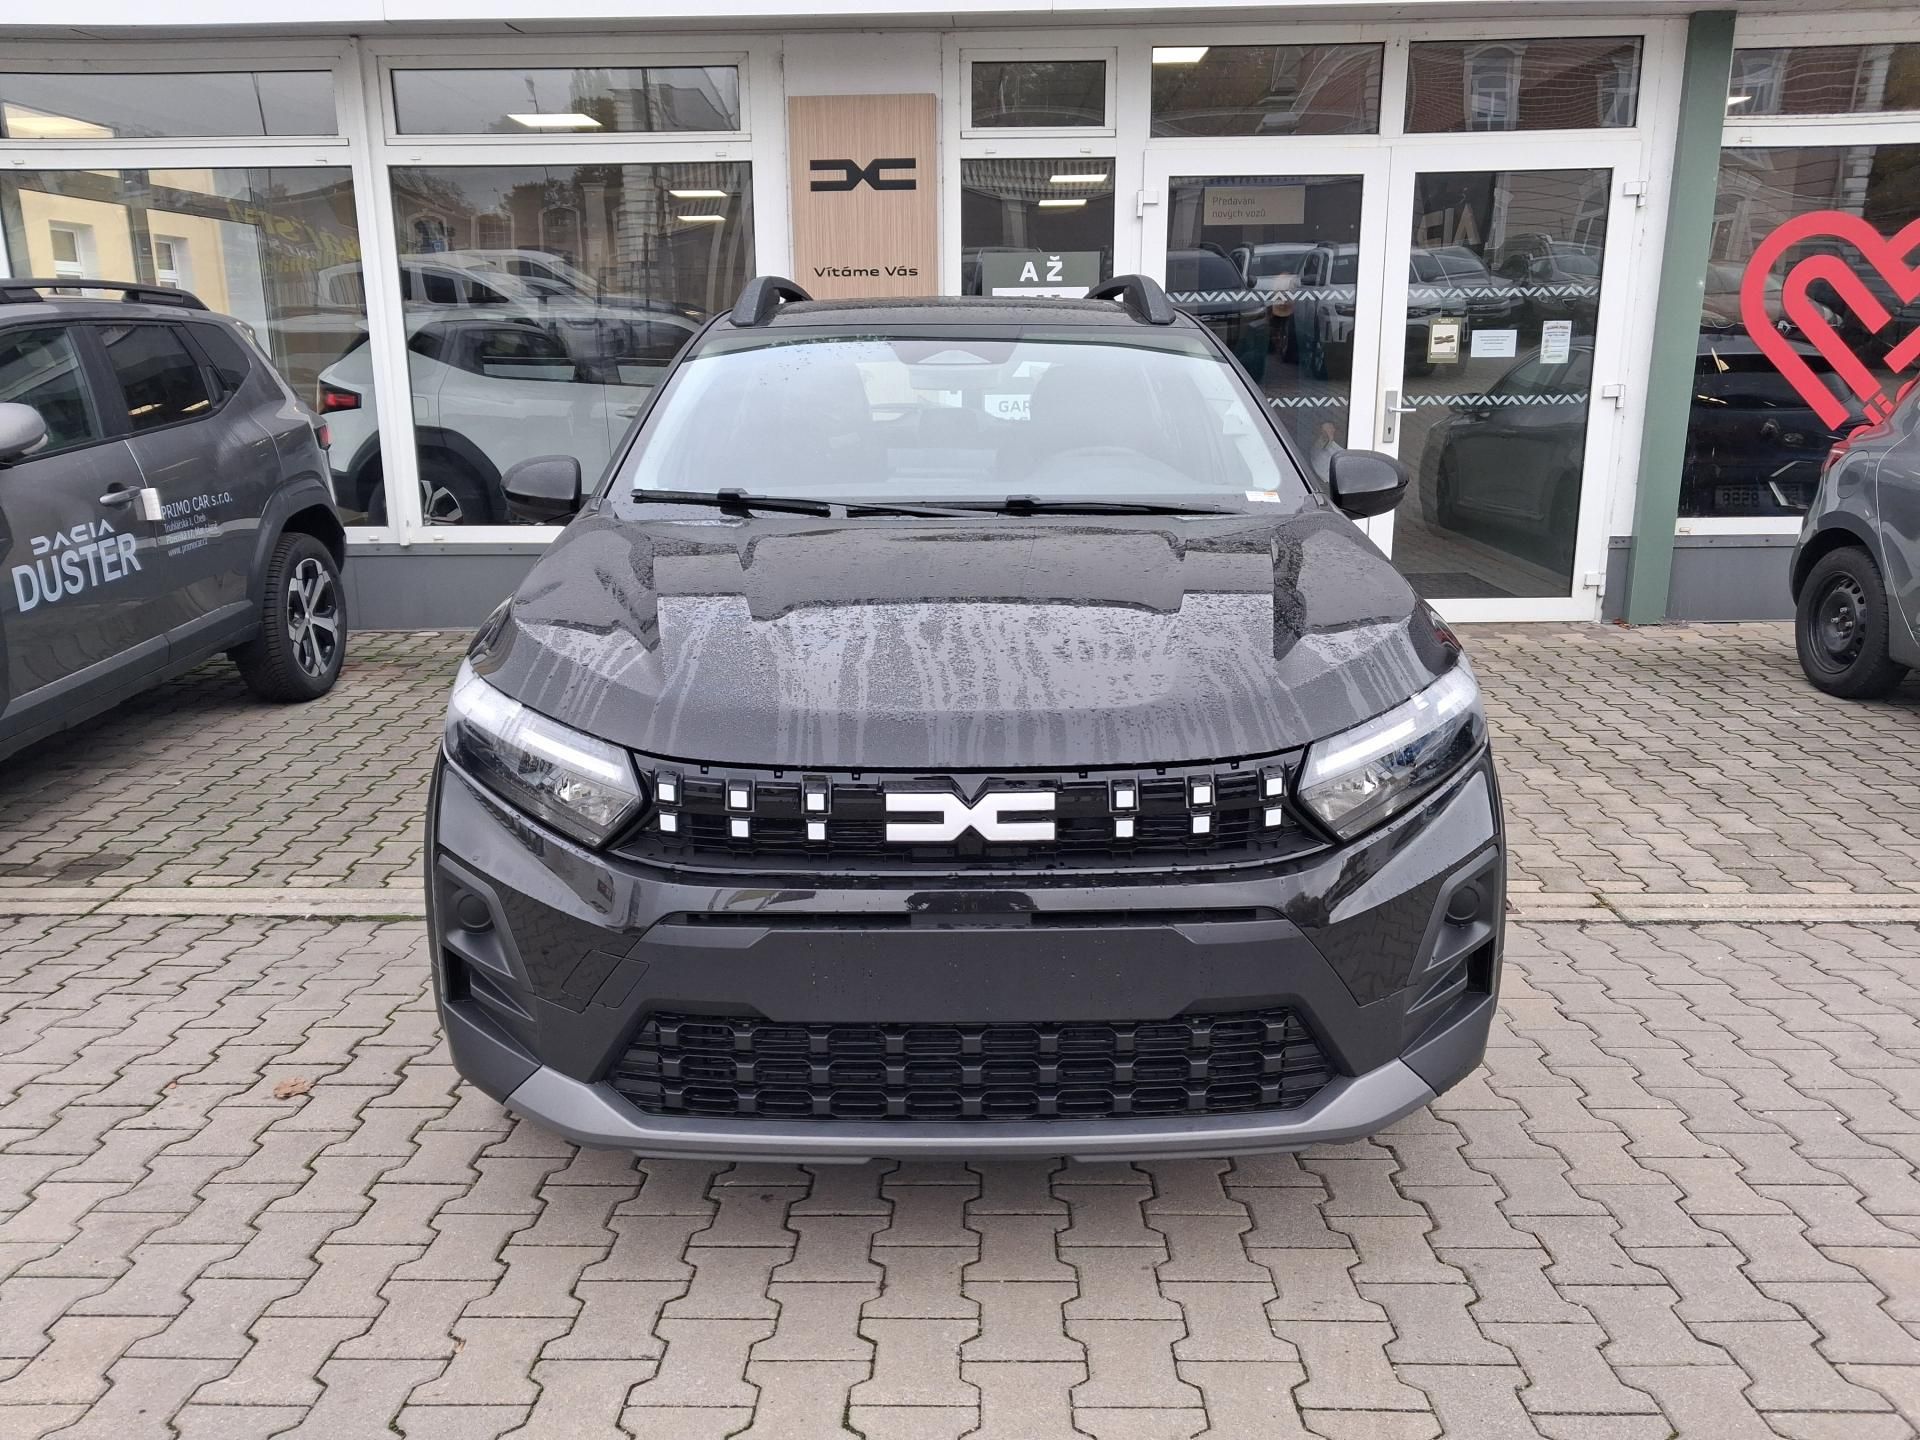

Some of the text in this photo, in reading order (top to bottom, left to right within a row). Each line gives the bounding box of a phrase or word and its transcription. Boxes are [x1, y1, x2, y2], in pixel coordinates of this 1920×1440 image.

[814, 265, 918, 277] Vítáme Vás
[161, 492, 233, 520] PRIMO CAR s.r.o.
[30, 518, 115, 555] DACIA
[11, 532, 142, 613] DUSTER
